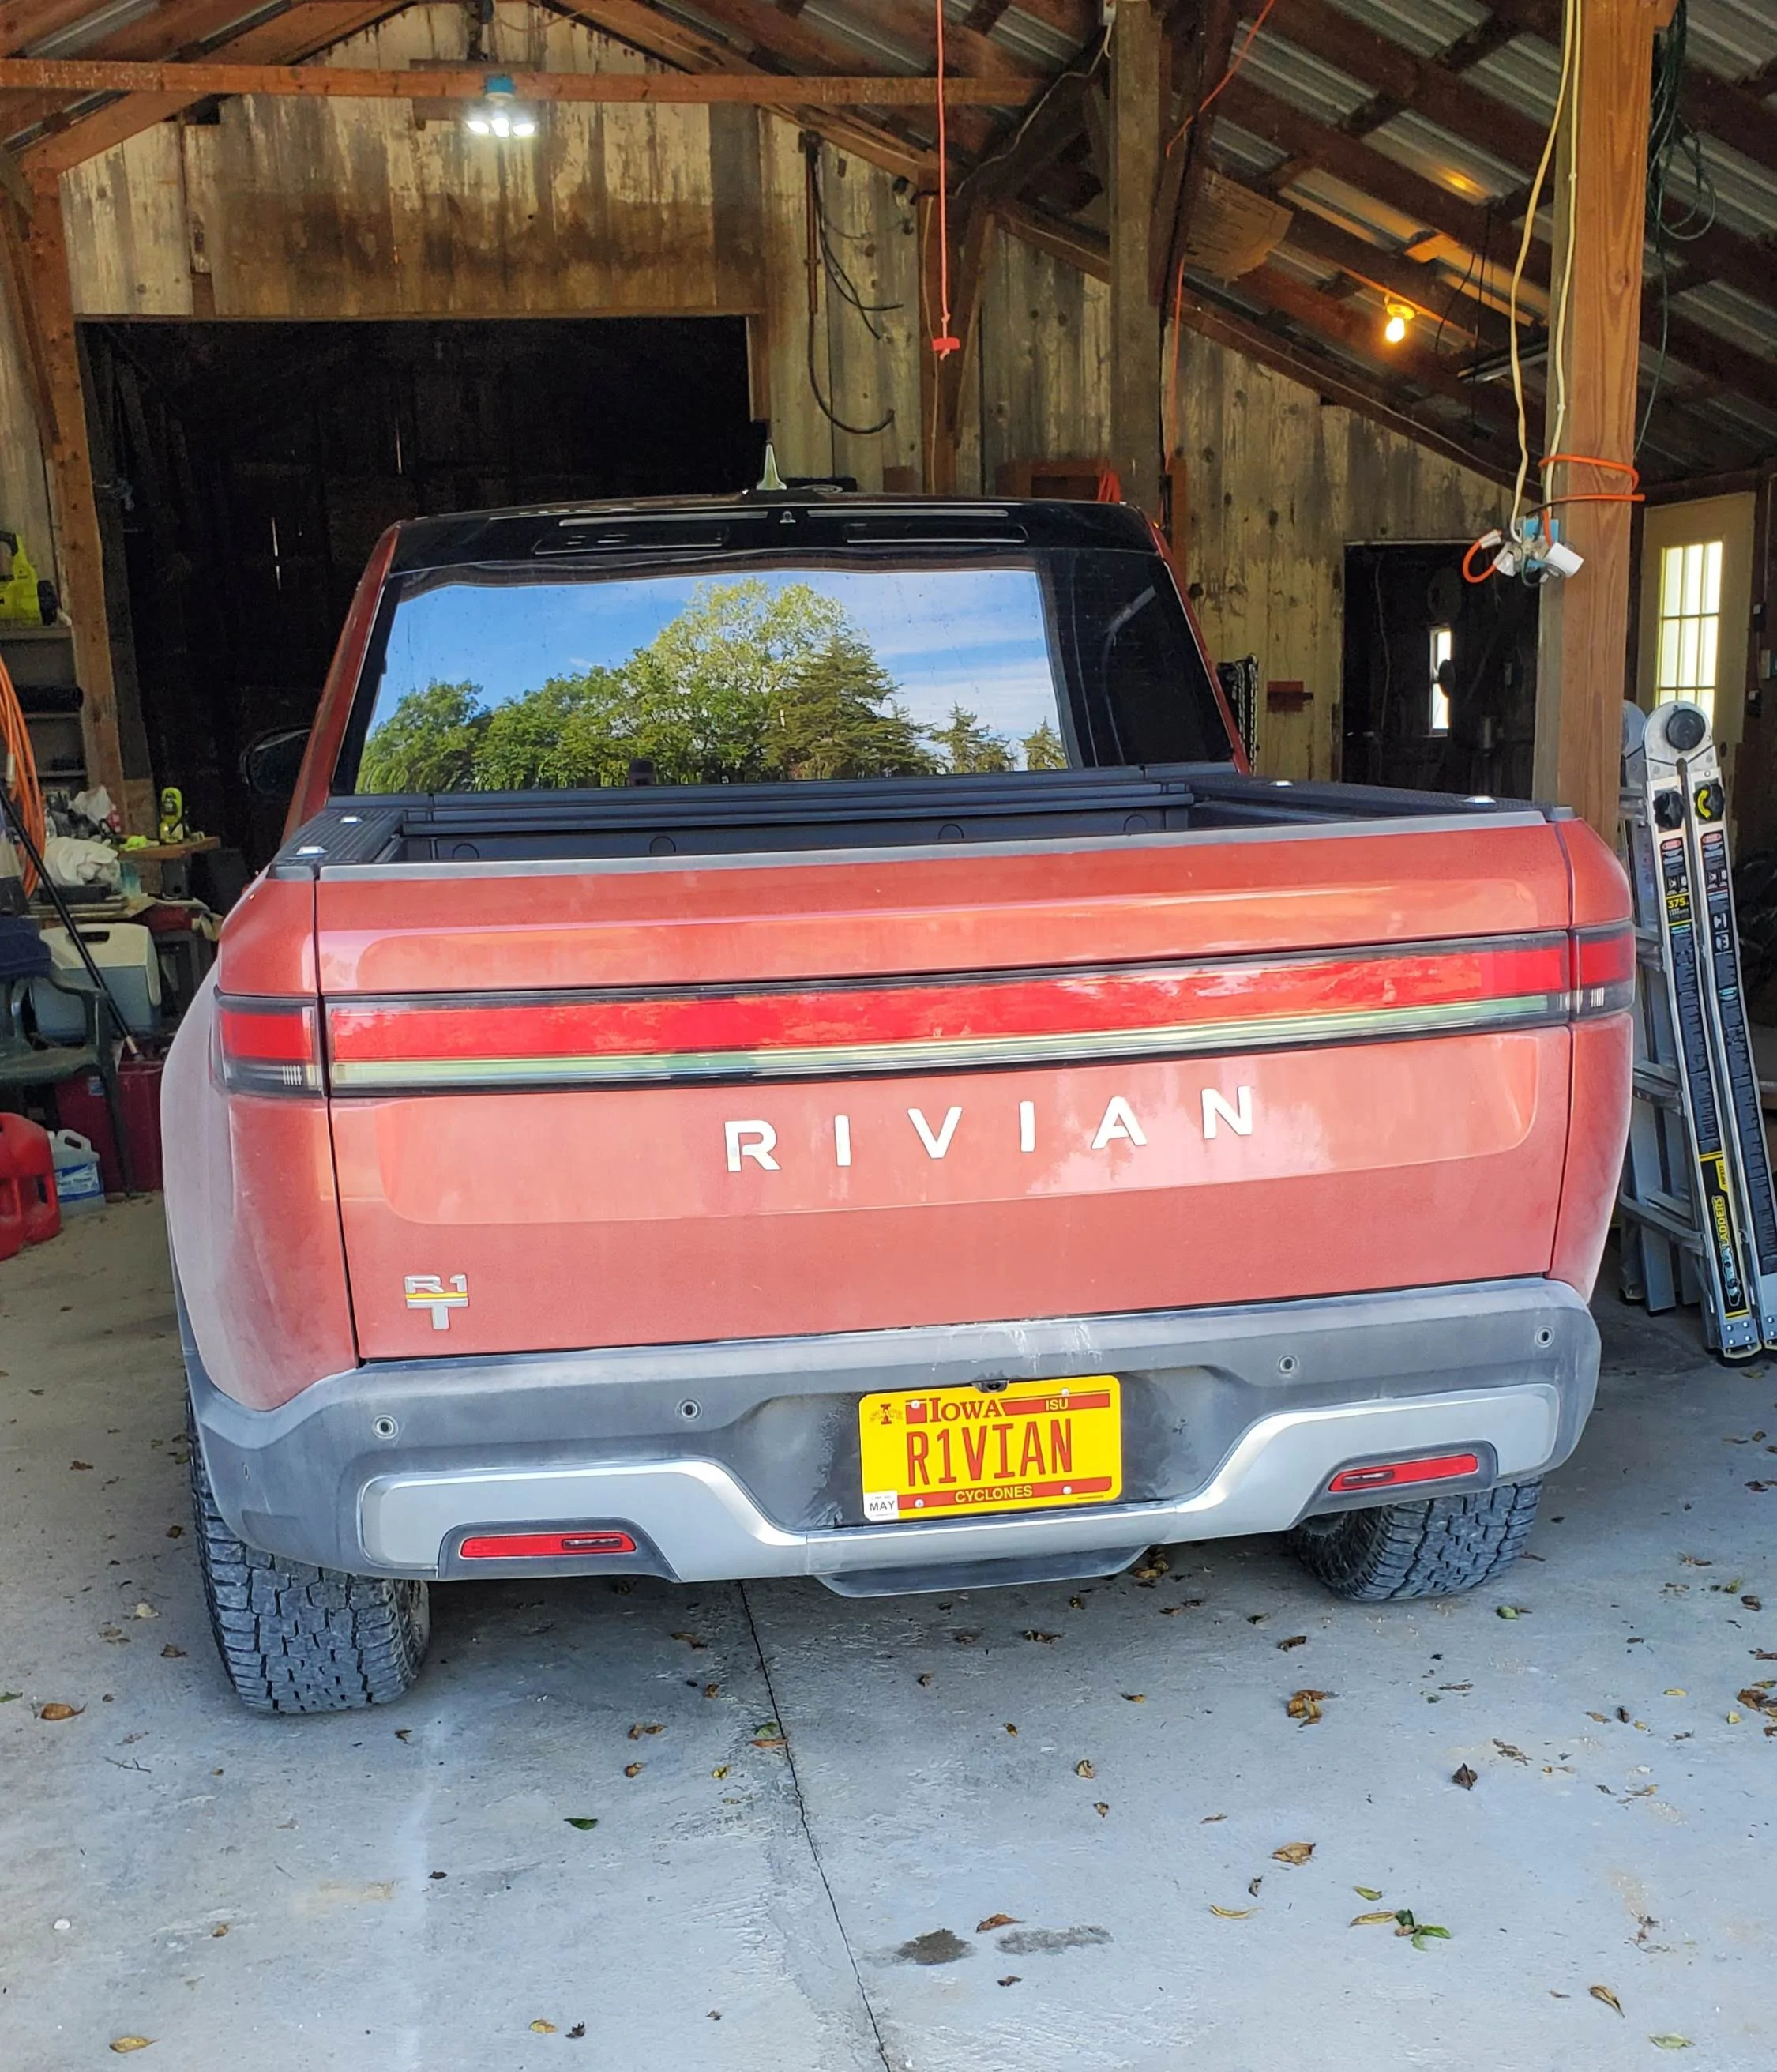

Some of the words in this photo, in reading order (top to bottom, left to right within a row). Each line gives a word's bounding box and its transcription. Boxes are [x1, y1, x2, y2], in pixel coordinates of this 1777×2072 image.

[1667, 897, 1686, 908] 375
[723, 1085, 1254, 1172] RIVIAN
[1714, 1197, 1729, 1247] LADDERS
[1045, 1398, 1069, 1411] ISU
[906, 1419, 1073, 1487] R1VIAN
[954, 1485, 1034, 1503] CYCLONES
[870, 1500, 896, 1511] MAY
